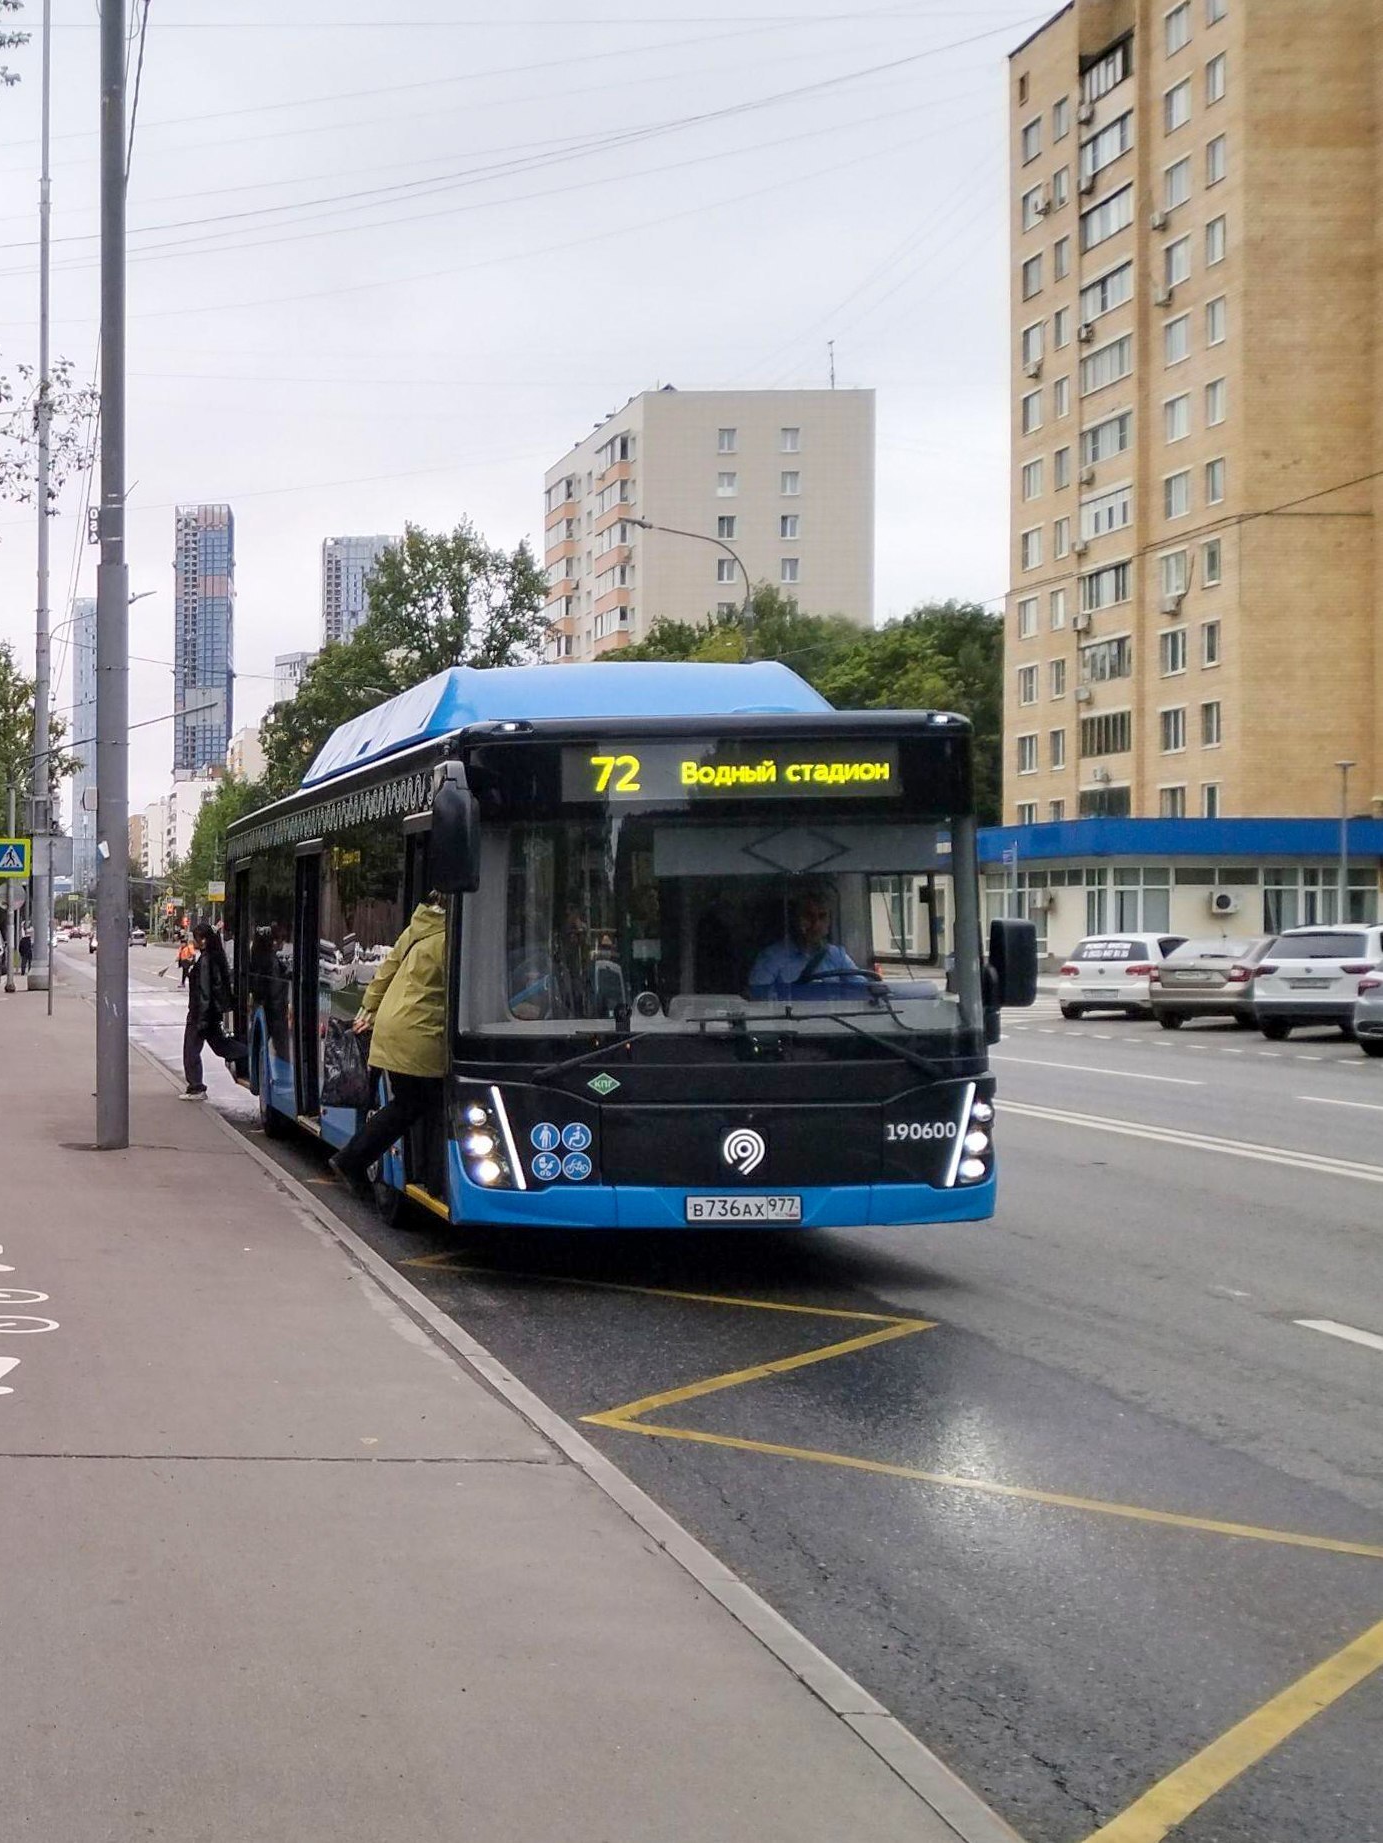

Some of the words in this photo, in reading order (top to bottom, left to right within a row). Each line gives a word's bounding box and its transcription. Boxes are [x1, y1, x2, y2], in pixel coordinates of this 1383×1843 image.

[590, 755, 641, 792] 72
[681, 760, 777, 787] Водный
[786, 761, 890, 785] стадион
[886, 1121, 956, 1141] 190600
[768, 1198, 796, 1212] 977
